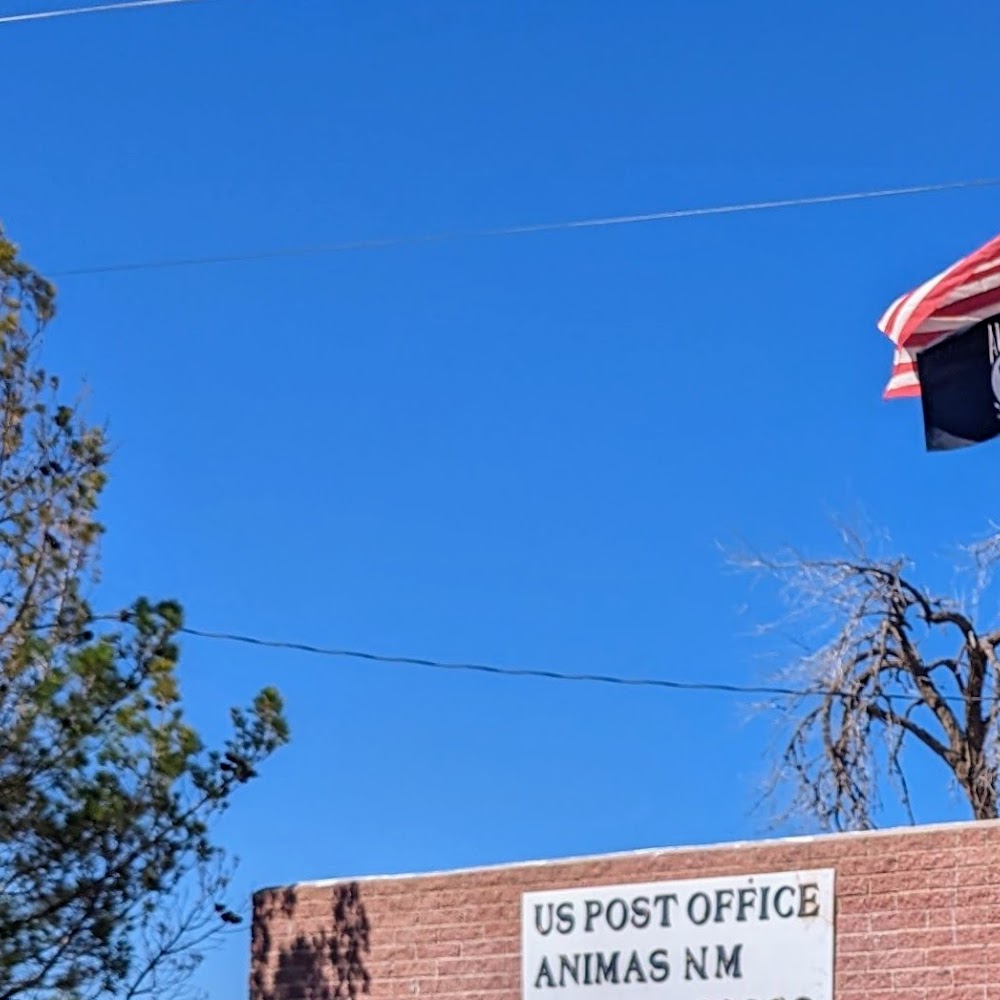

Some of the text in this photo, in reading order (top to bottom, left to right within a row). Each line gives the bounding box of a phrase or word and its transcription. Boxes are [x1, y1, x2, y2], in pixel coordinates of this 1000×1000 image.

[534, 883, 821, 935] US POST OFFICE
[534, 949, 670, 988] ANIMAS
